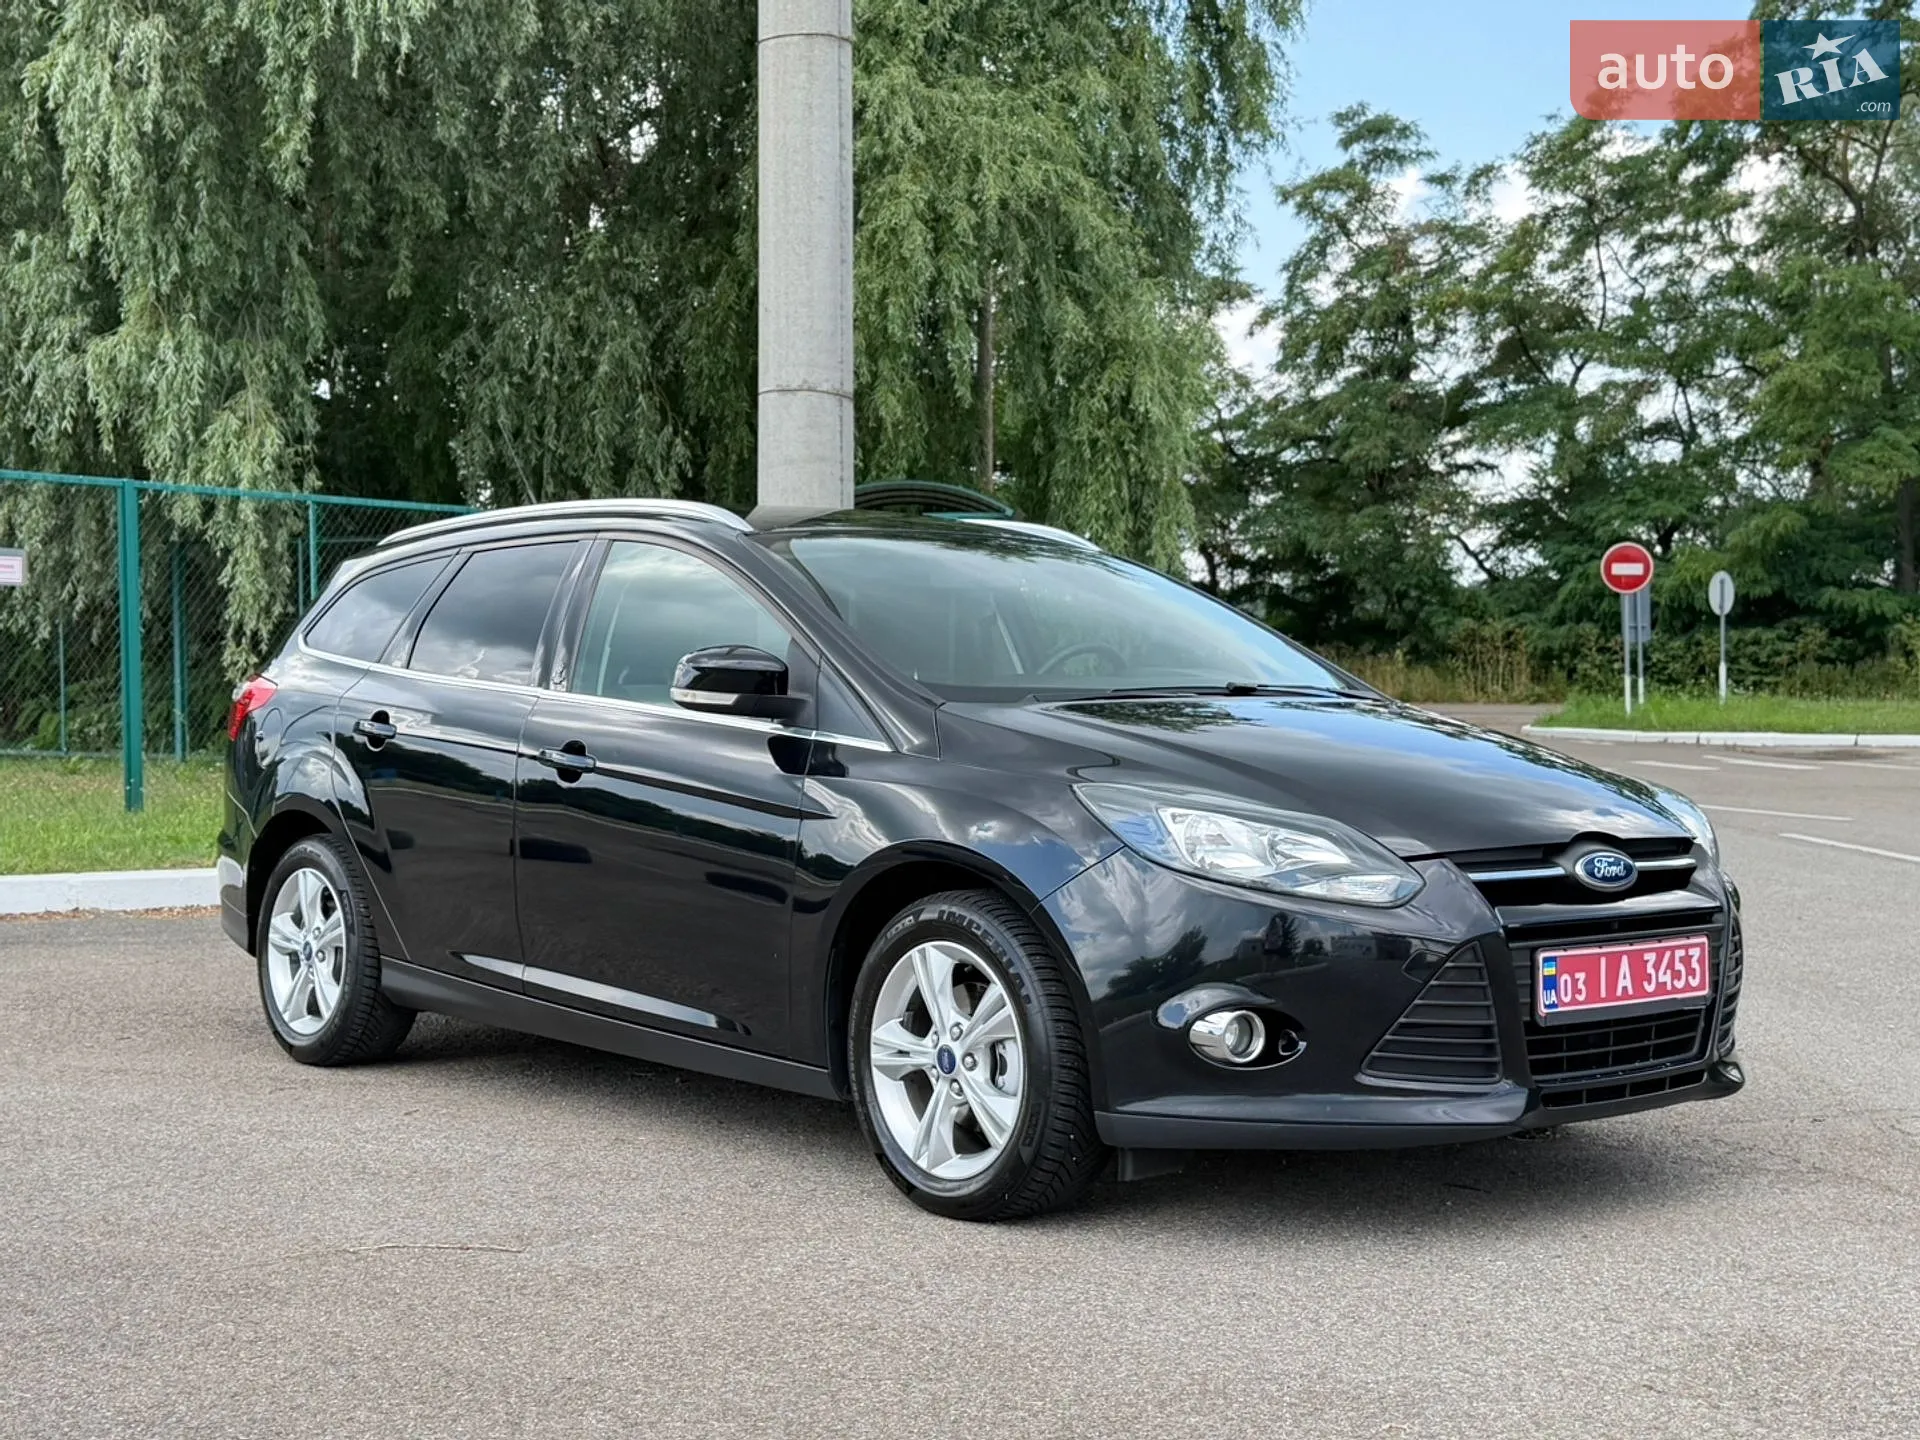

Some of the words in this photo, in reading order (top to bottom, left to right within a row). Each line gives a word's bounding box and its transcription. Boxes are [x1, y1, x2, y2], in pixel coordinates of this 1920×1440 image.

[1594, 857, 1627, 879] Ford
[937, 909, 1033, 1005] IMPERIAL
[1560, 972, 1587, 1003] 03
[1642, 947, 1701, 993] 3453
[1543, 990, 1557, 1005] UA
